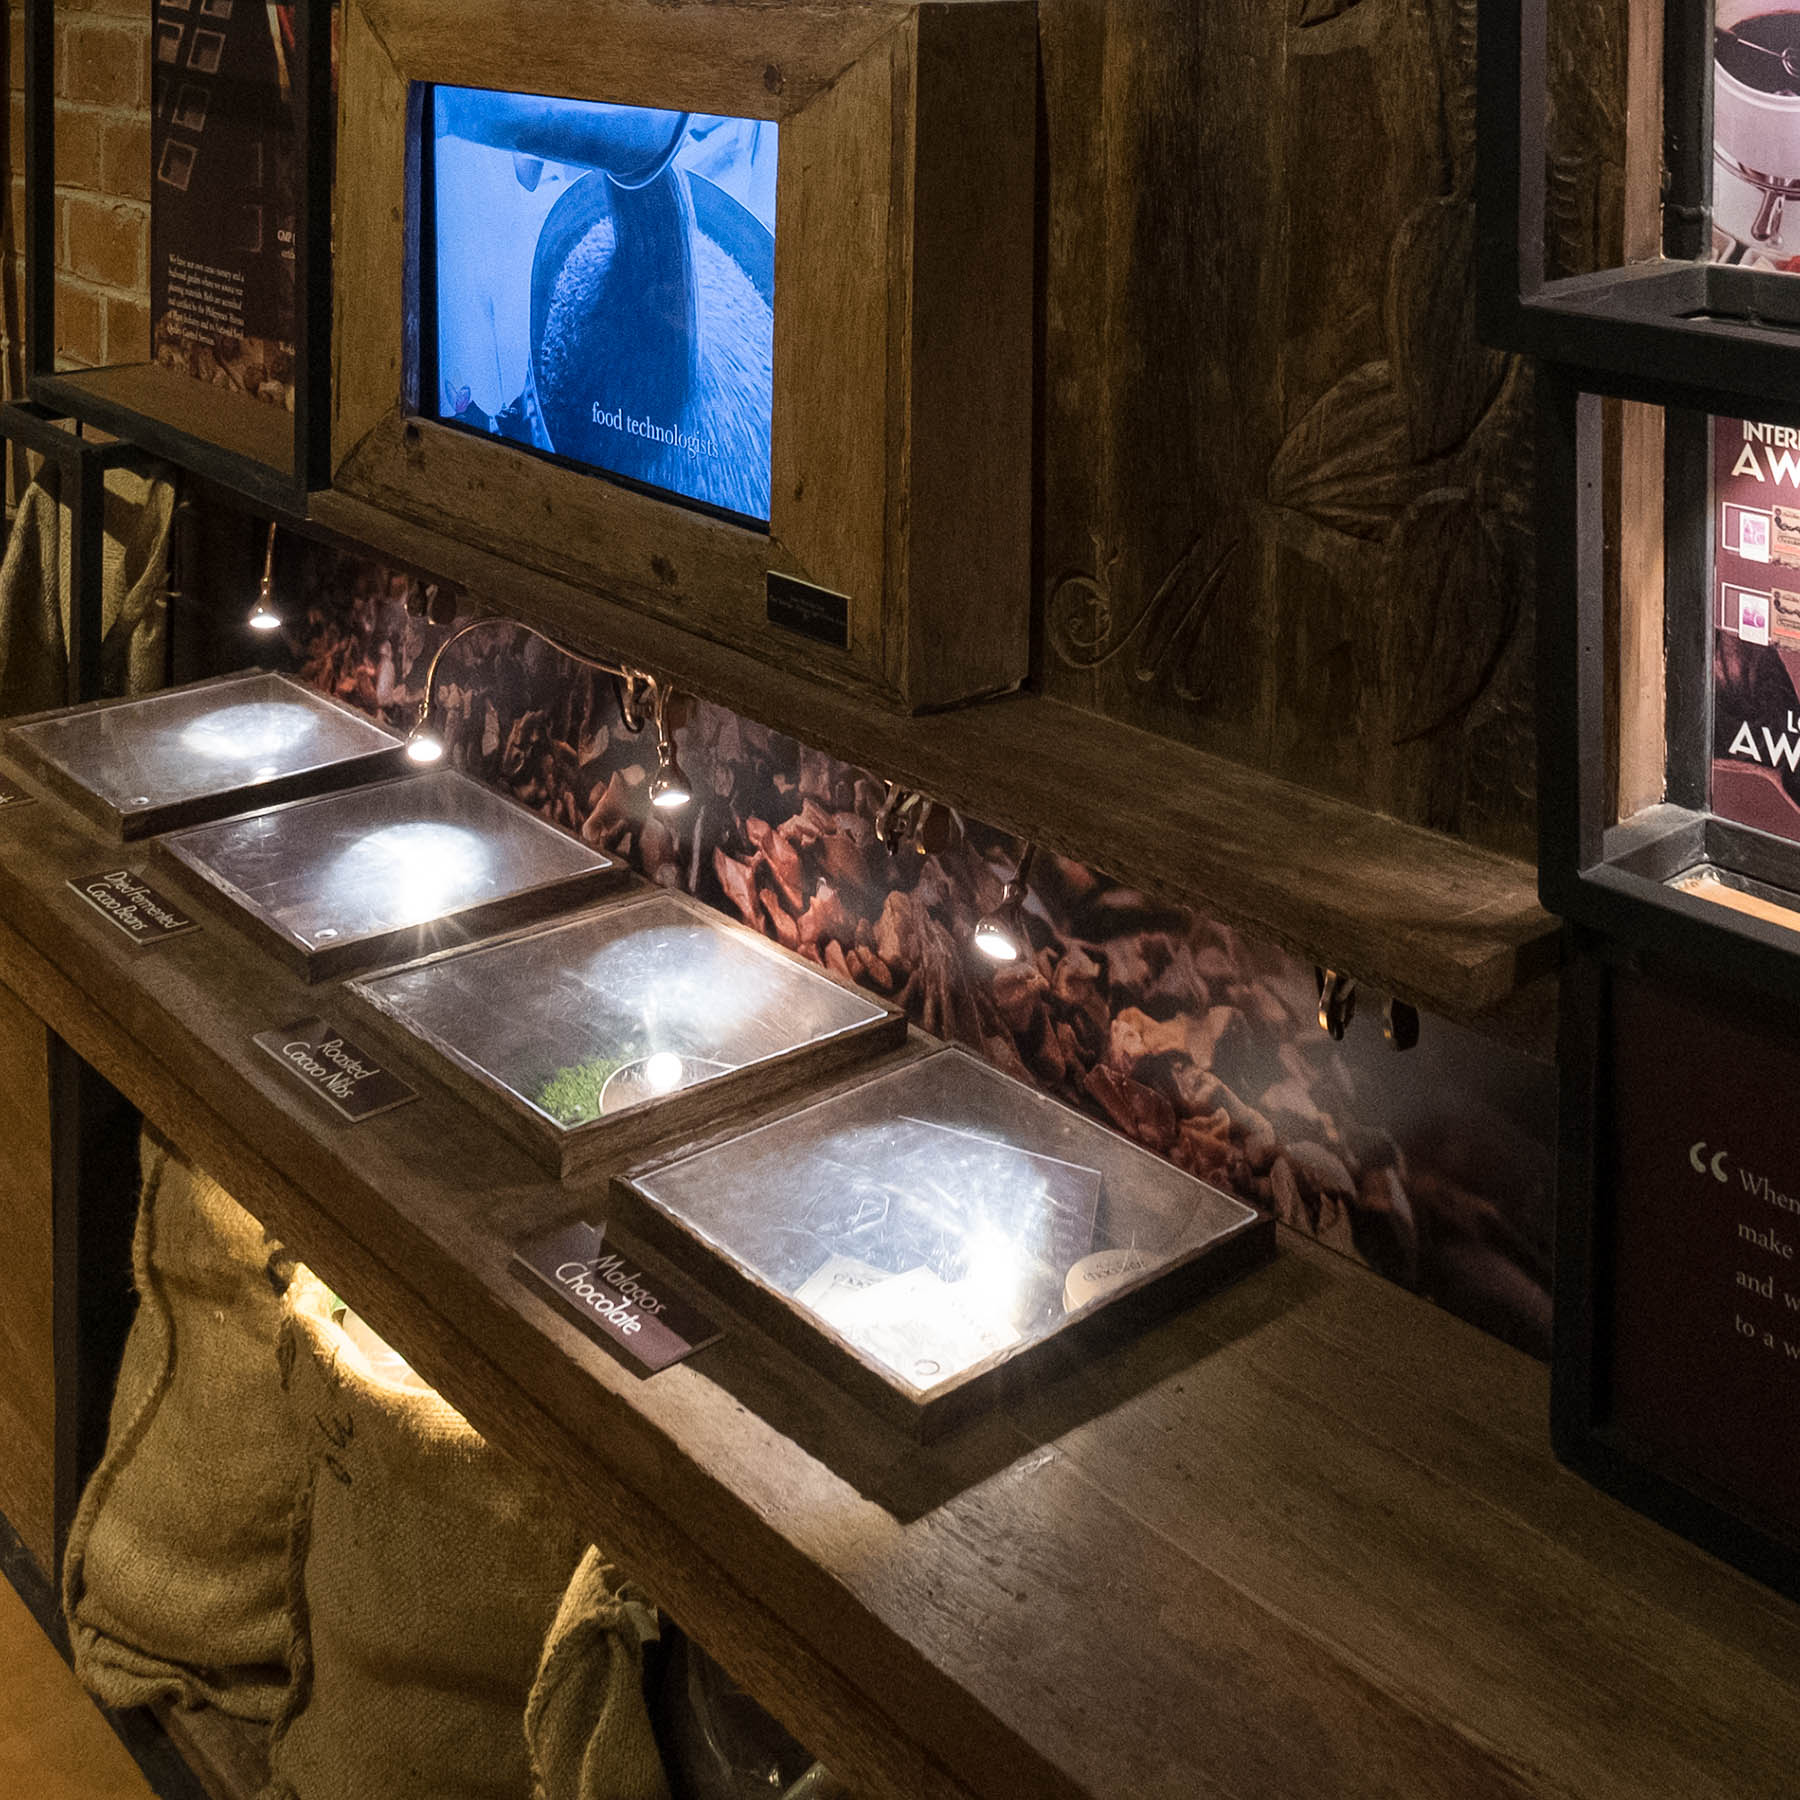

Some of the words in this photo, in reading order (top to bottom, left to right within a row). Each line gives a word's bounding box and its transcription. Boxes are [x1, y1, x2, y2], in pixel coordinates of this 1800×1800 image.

[592, 401, 623, 431] food
[627, 416, 719, 459] technologists
[86, 882, 121, 912] Cacao
[115, 906, 148, 931] Beans
[104, 871, 137, 896] Dried
[131, 888, 189, 930] Fermented
[282, 1041, 326, 1077] Cacao
[320, 1071, 354, 1098] Nibs
[318, 1038, 380, 1080] Roasted
[1737, 1221, 1794, 1259] make
[555, 1262, 642, 1336] Chocolate
[587, 1254, 667, 1315] Malagos
[1735, 1268, 1773, 1299] and
[1735, 1312, 1755, 1339] to
[1763, 1330, 1775, 1349] a
